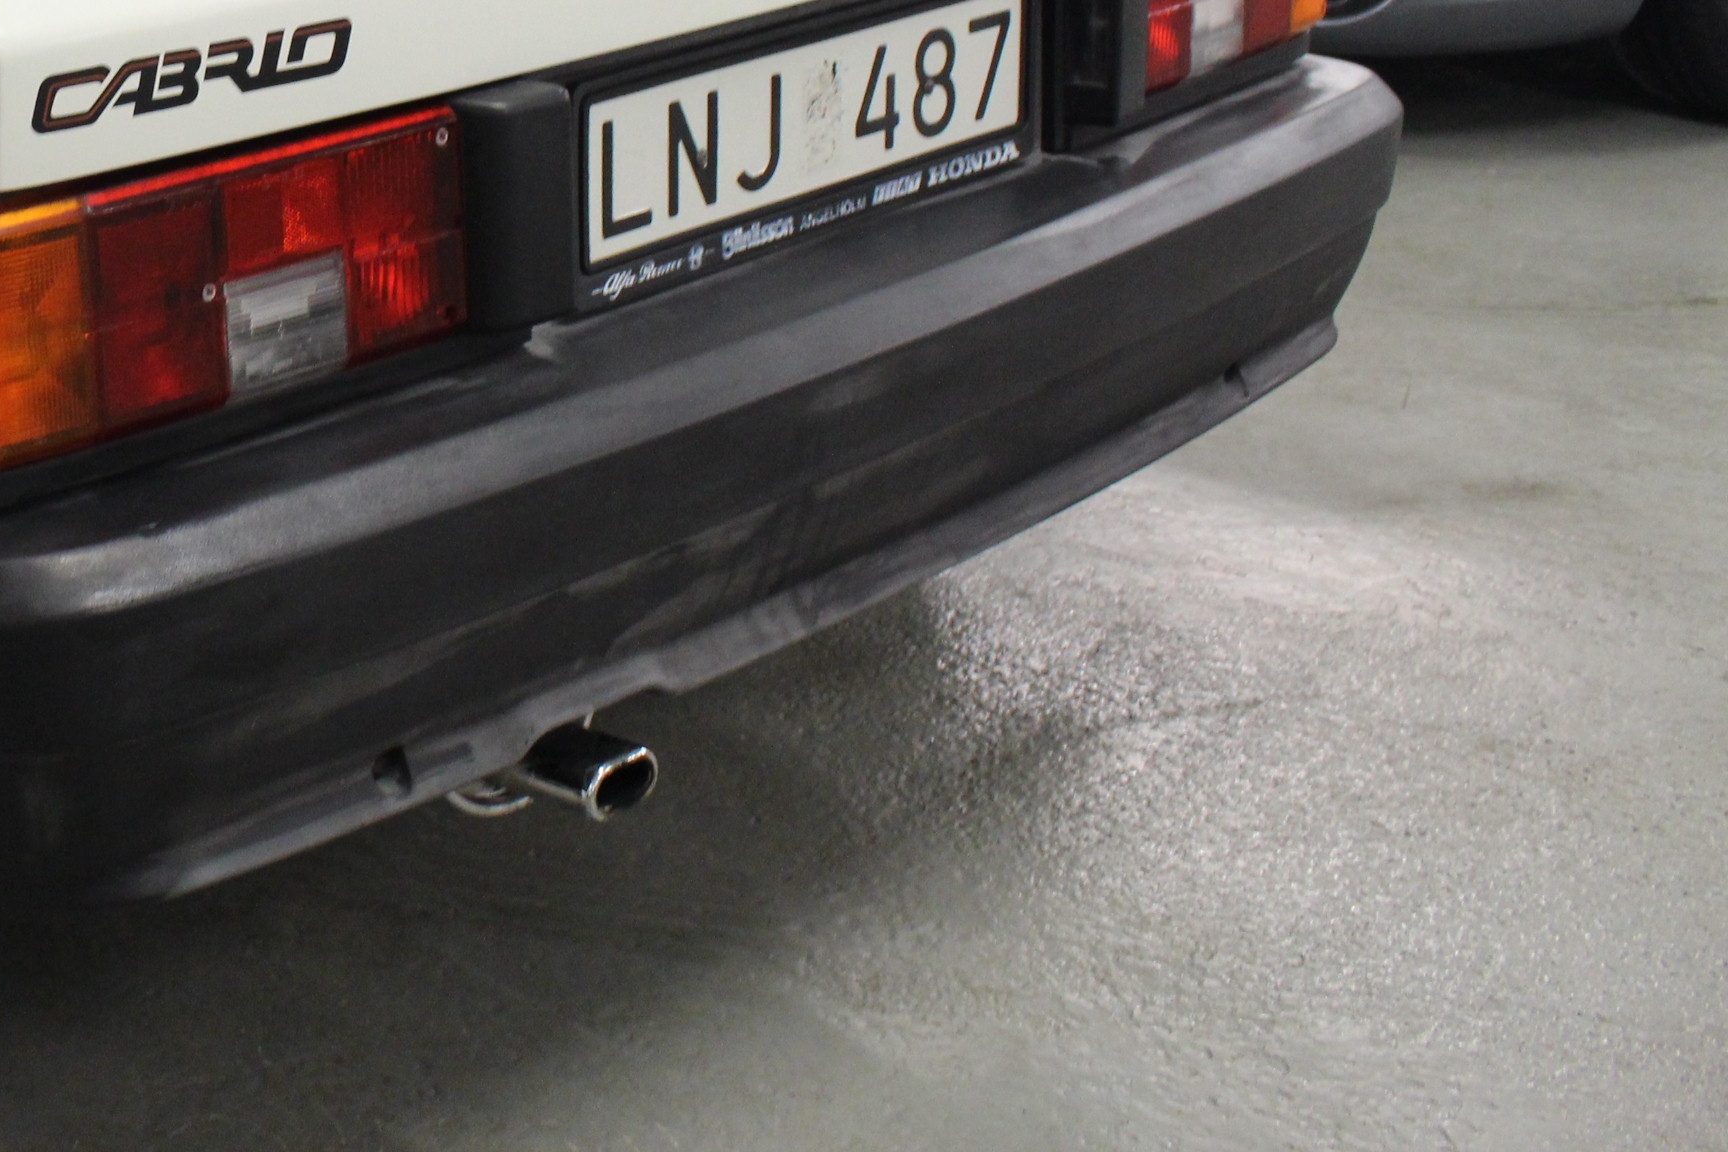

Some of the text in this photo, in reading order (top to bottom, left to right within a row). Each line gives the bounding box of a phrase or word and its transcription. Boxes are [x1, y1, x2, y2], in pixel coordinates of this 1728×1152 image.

[31, 17, 352, 134] CABRIO
[602, 10, 1011, 239] LNJ 487
[603, 270, 636, 301] Alfa
[872, 171, 922, 206] FIAT
[927, 140, 1020, 187] HONDA
